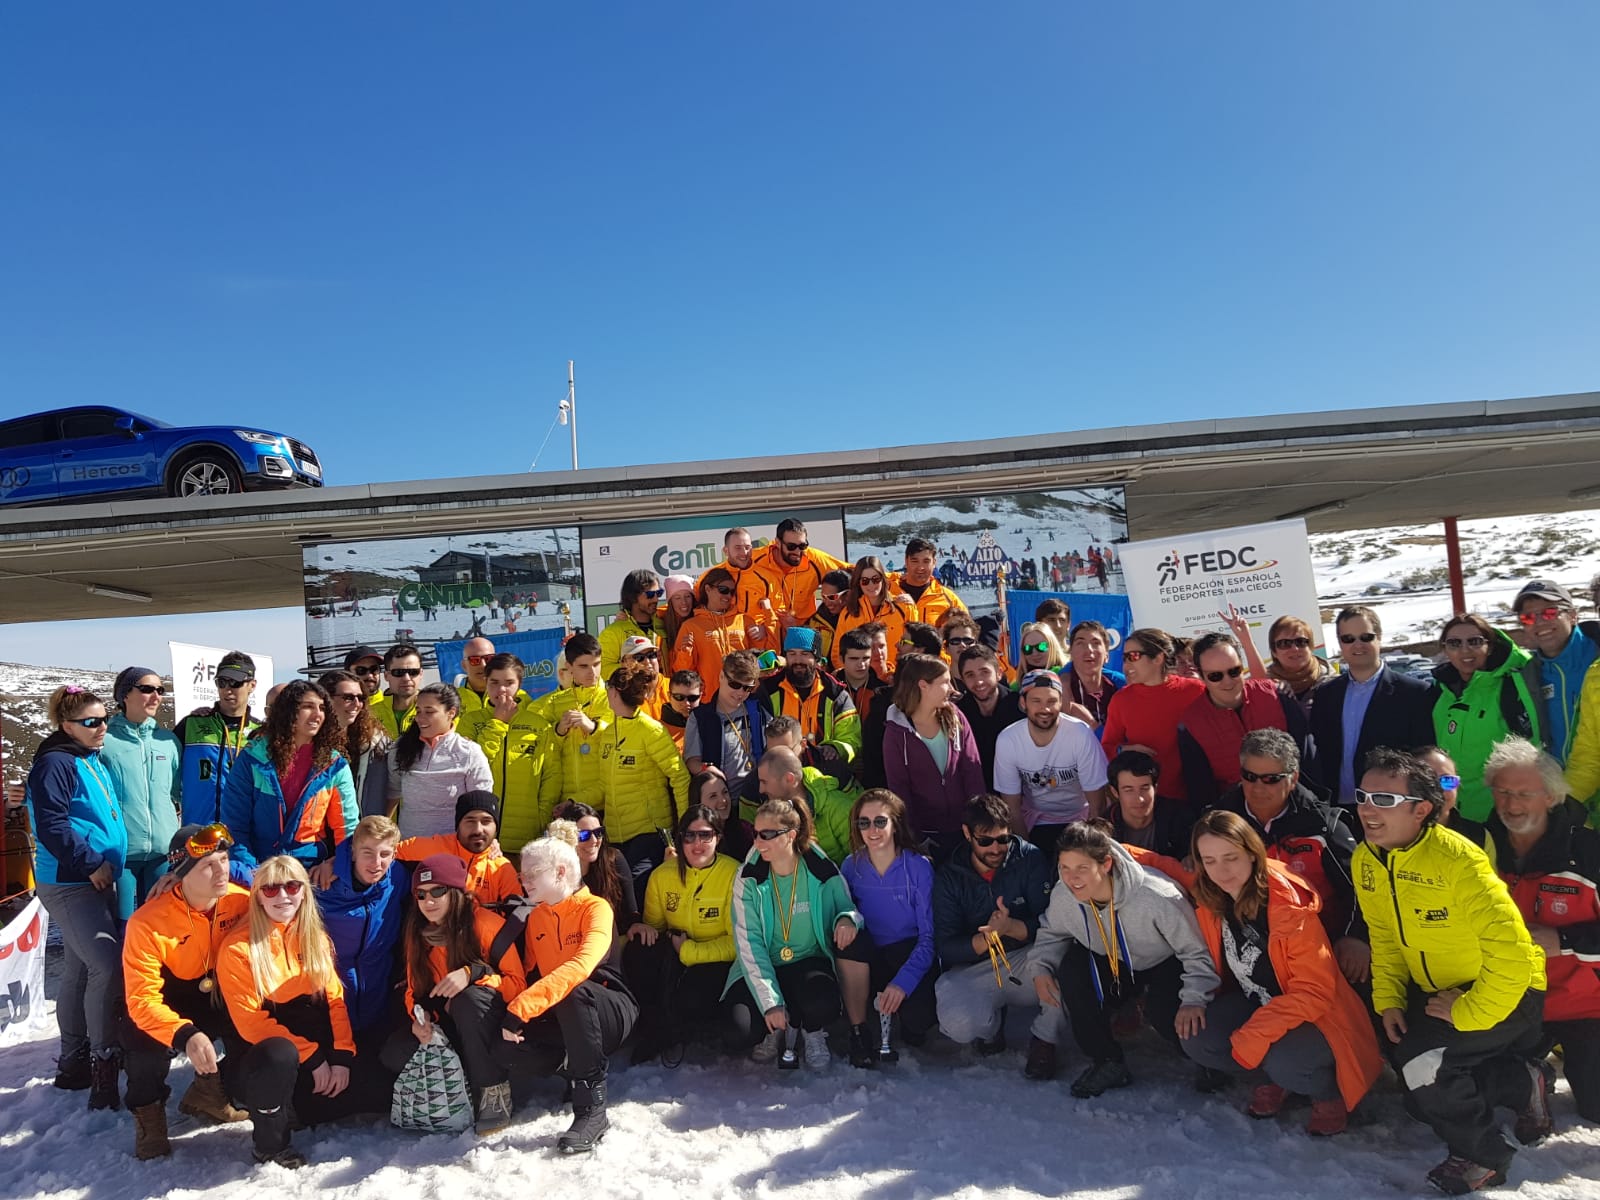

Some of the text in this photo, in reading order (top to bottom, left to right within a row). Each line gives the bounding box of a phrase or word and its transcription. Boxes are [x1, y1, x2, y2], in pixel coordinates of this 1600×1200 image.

[72, 463, 140, 480] Hercos
[652, 542, 728, 577] CanTu
[976, 548, 1002, 561] ALTO
[1183, 546, 1258, 575] FEDC
[1160, 572, 1280, 595] FEDERACIÓN ESPAÑOLA
[1173, 588, 1224, 602] DEPORTES
[1246, 580, 1282, 592] CIEGOS
[399, 582, 493, 611] CANTUR
[1185, 614, 1206, 622] grupo
